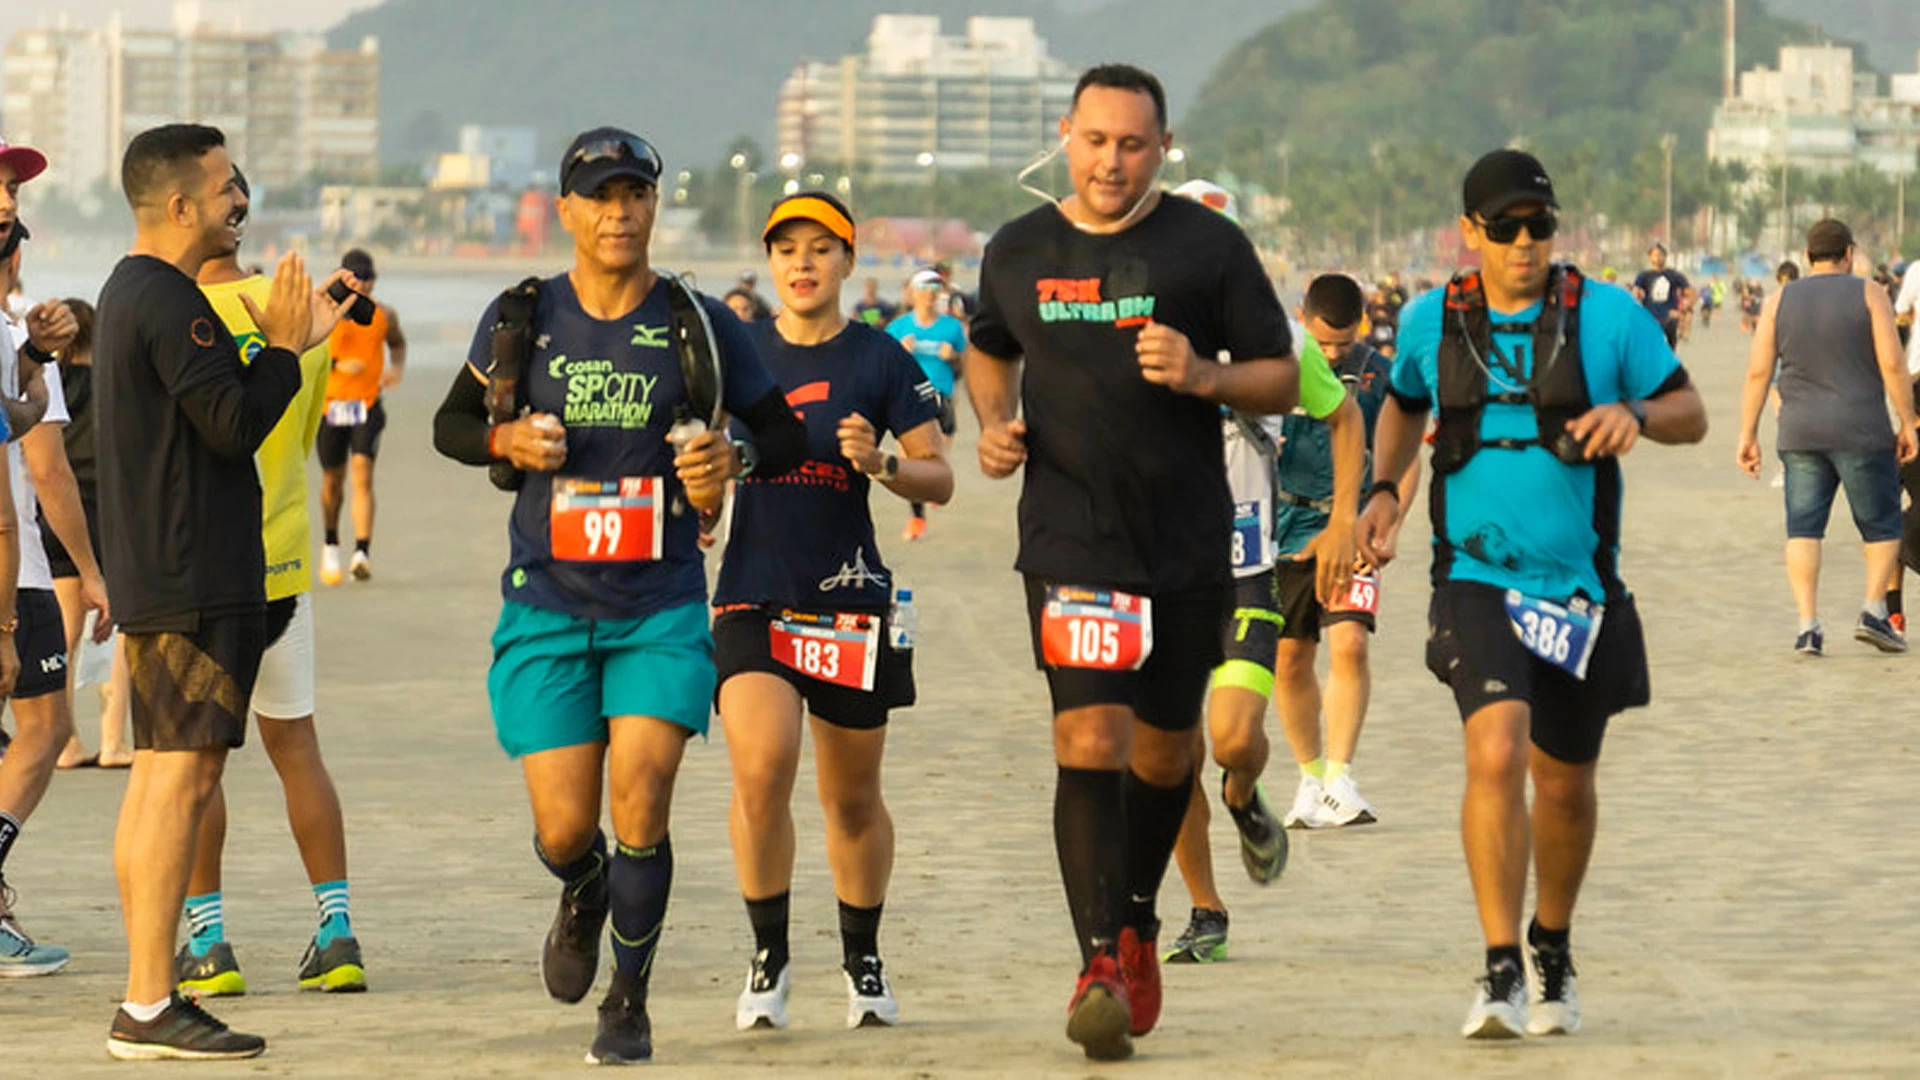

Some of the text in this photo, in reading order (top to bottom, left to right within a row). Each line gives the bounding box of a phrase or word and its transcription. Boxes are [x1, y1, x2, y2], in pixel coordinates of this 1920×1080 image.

[1038, 299, 1117, 322] ULTRA
[564, 359, 613, 375] cosan
[563, 401, 653, 423] MARATHON
[583, 510, 623, 556] 99
[1349, 582, 1376, 609] 49
[1066, 617, 1121, 665] 105
[1521, 609, 1573, 664] 386
[790, 636, 841, 679] 183
